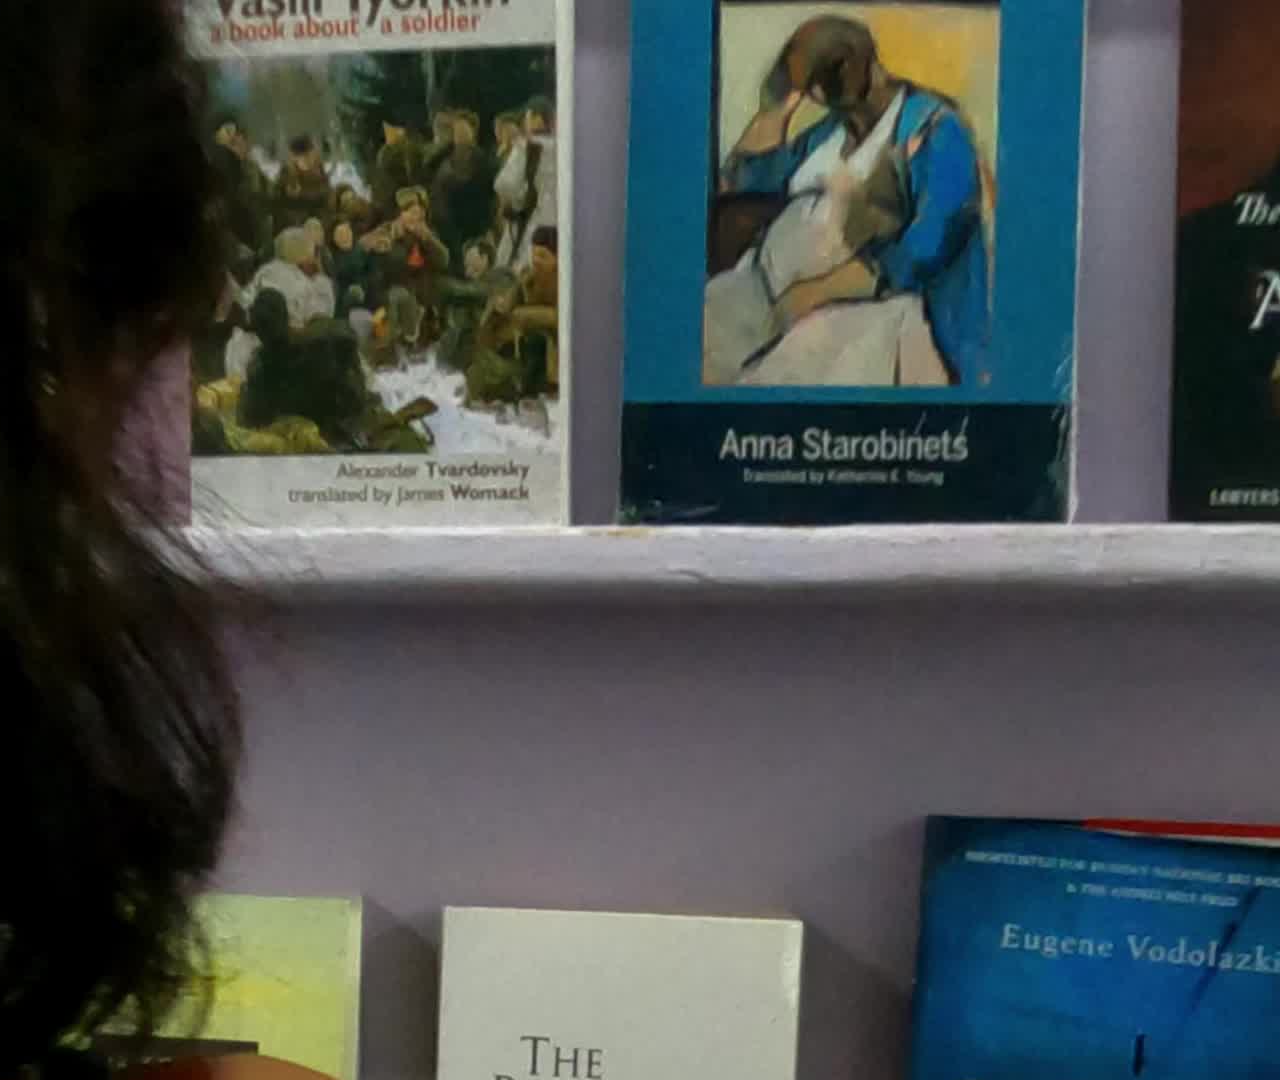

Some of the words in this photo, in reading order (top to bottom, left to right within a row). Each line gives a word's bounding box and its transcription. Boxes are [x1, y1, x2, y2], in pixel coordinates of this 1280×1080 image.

[230, 17, 285, 42] book
[293, 15, 359, 38] about
[381, 16, 393, 34] a
[400, 8, 480, 33] soldier
[719, 427, 794, 461] Anna
[802, 427, 969, 462] Starobinets
[336, 462, 419, 479] Alexander
[425, 459, 530, 481] Tvardovsky
[288, 485, 368, 503] translated
[372, 485, 392, 505] by
[395, 485, 445, 506] James
[449, 482, 530, 501] Womack
[1000, 922, 1115, 958] Eugene
[519, 1035, 604, 1080] THE
